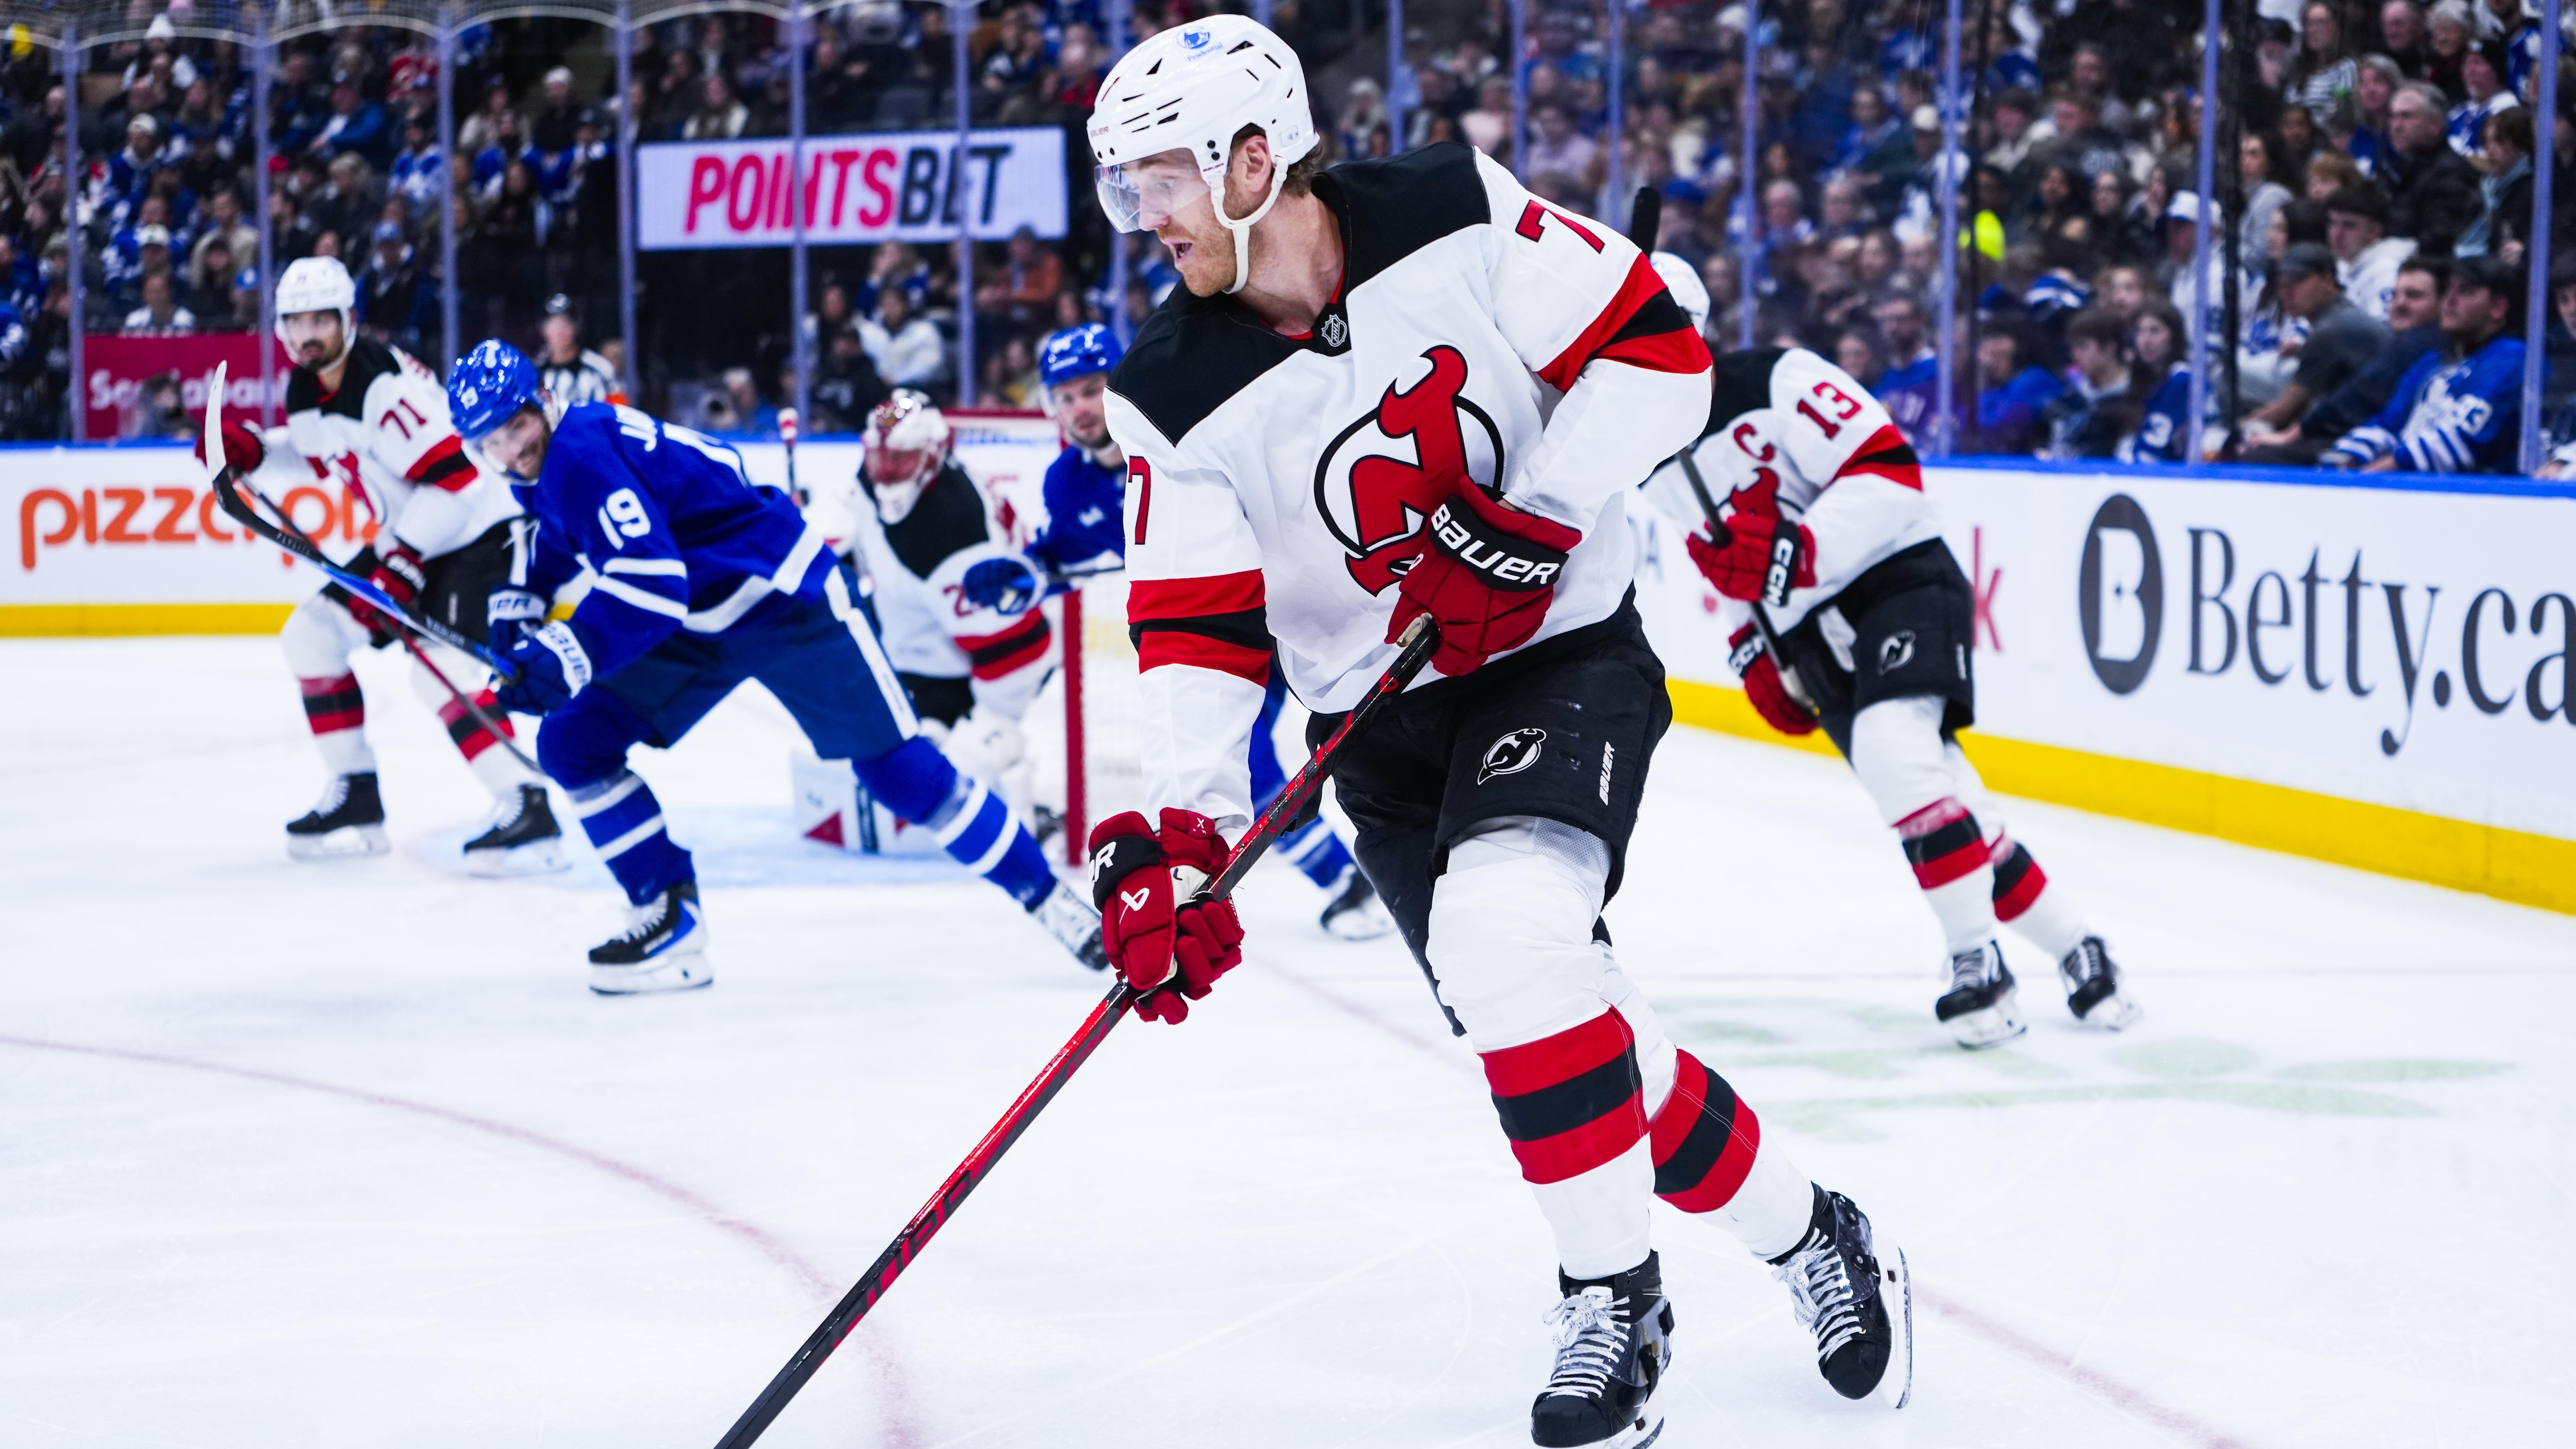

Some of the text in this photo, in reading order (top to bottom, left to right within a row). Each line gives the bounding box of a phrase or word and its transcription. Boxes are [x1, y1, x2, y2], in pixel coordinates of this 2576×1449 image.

[1187, 43, 1224, 61] Prudential
[685, 145, 1011, 233] POINTSBET
[1515, 199, 1605, 253] 7
[380, 398, 426, 440] 71
[1733, 422, 1775, 462] C
[1797, 381, 1863, 439] 13
[20, 488, 258, 571] pizza
[599, 487, 651, 551] 19
[1128, 455, 1151, 544] 7
[1765, 537, 1794, 606] CCM
[2186, 526, 2576, 757] Betty.ca
